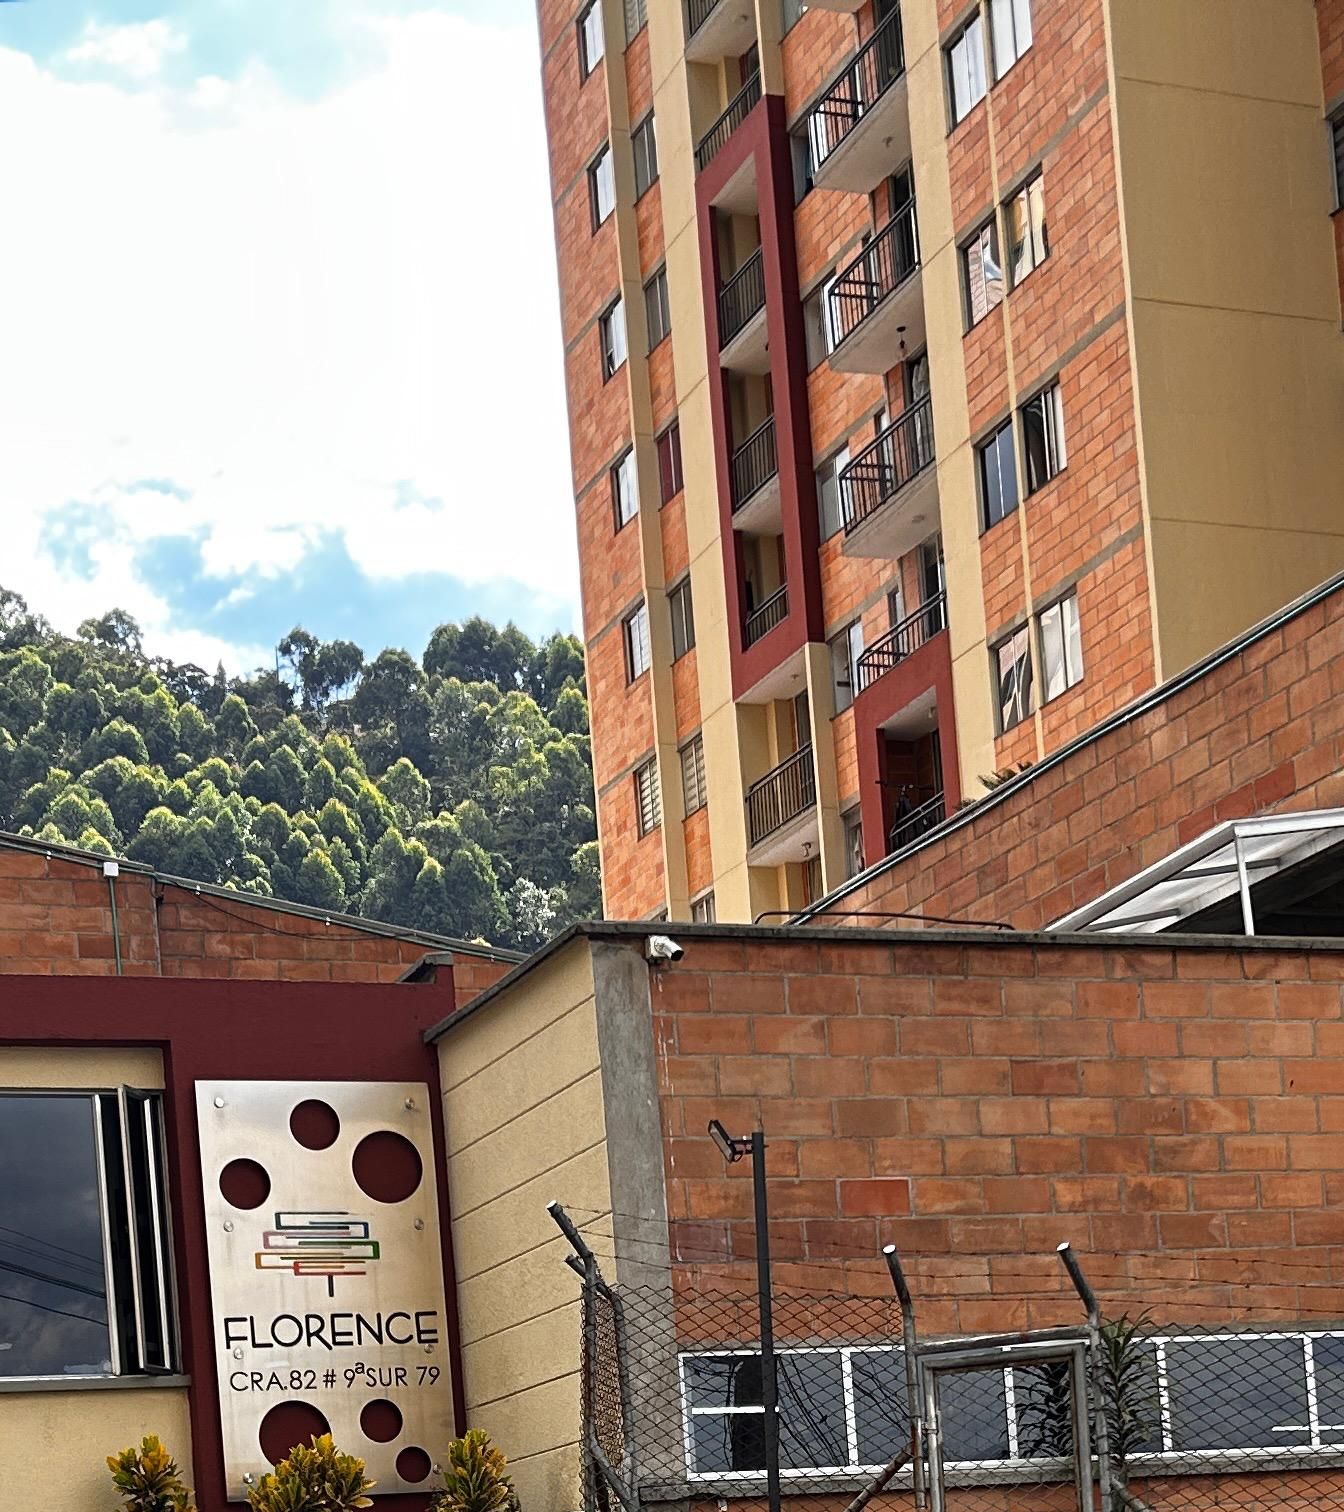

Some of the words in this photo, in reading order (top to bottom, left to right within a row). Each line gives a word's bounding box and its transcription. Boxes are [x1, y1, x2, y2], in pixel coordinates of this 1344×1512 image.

[224, 1311, 439, 1350] FLORENCE
[322, 1368, 337, 1389] #
[416, 1366, 441, 1386] 79
